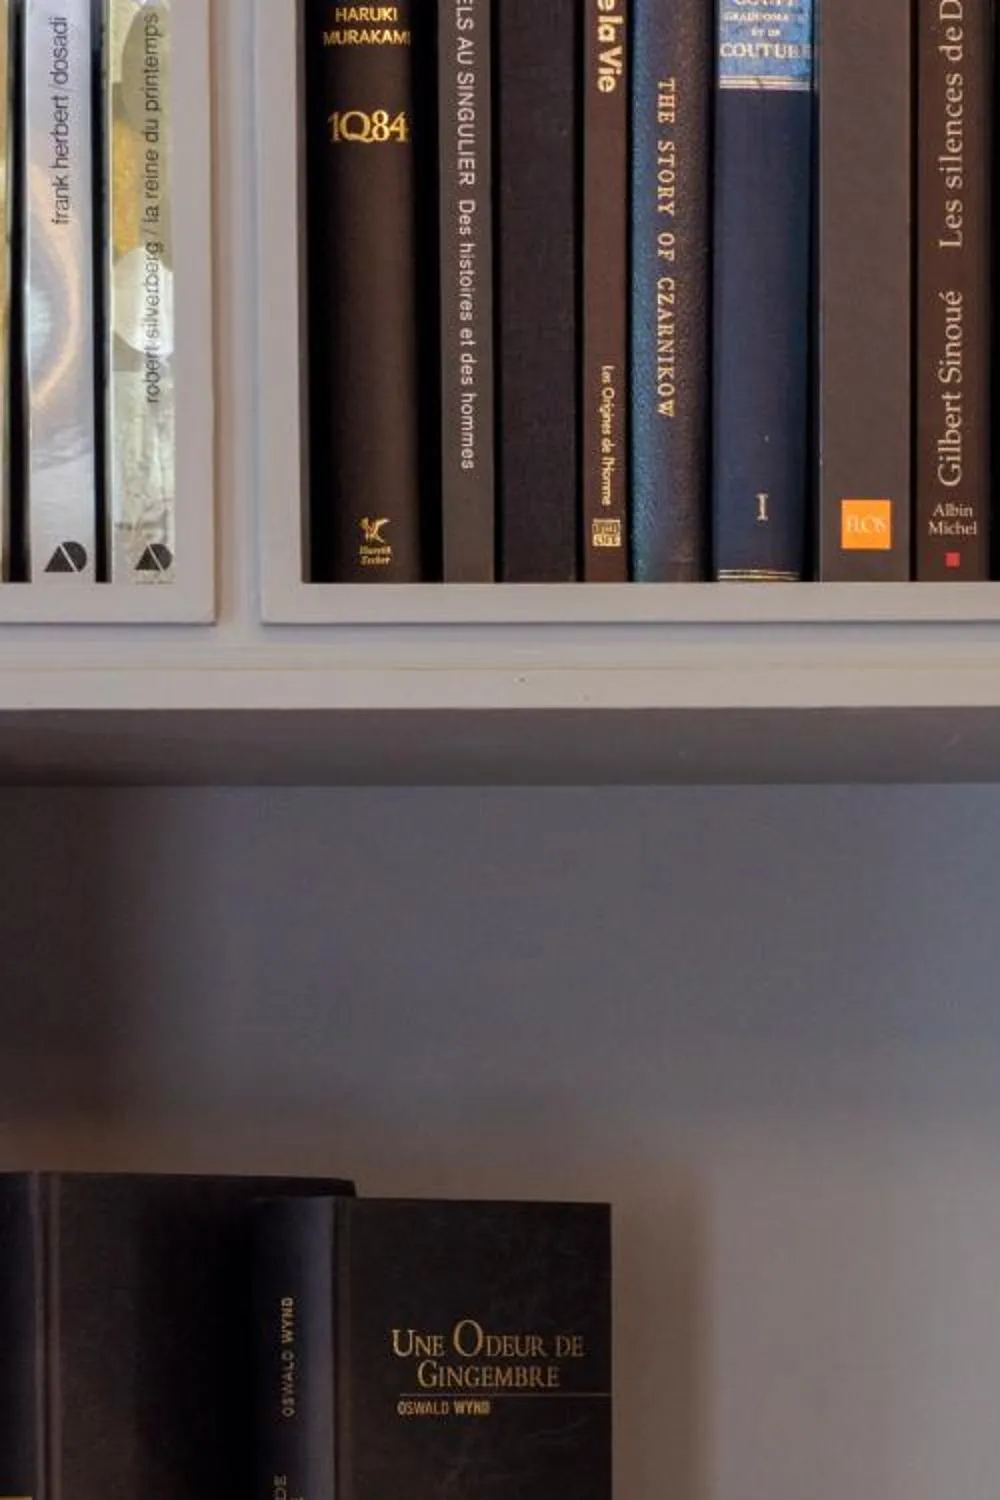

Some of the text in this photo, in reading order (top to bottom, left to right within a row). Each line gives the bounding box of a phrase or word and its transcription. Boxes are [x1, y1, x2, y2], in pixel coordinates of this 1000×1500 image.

[322, 29, 411, 46] MURAKAMI
[335, 7, 398, 22] HARUKI
[597, 15, 624, 43] la
[142, 12, 162, 113] printemps
[456, 37, 475, 66] AU
[937, 25, 963, 62] de
[597, 46, 623, 93] Vie
[49, 94, 69, 170] herbert
[141, 118, 160, 144] du
[327, 109, 410, 143] 1Q84
[456, 71, 476, 187] SINGULIER
[938, 71, 963, 190] silences
[143, 149, 161, 200] reine
[51, 174, 70, 226] frank
[142, 204, 160, 224] la
[458, 199, 477, 236] Des
[938, 198, 963, 249] Les
[656, 77, 676, 418] THE STORY OF CZARNIKOW
[141, 240, 165, 341] silverberg
[459, 243, 477, 322] histoires
[459, 327, 477, 347] et
[937, 290, 963, 384] Sinoué
[143, 347, 161, 404] robert
[460, 353, 478, 386] des
[460, 392, 478, 471] hommes
[937, 391, 963, 487] Gilbert
[927, 519, 978, 537] Michel
[931, 502, 974, 518] Albin
[280, 1297, 296, 1418] OSWALD WYND
[555, 1335, 586, 1358] DE
[397, 1399, 492, 1416] OSWALD WYND
